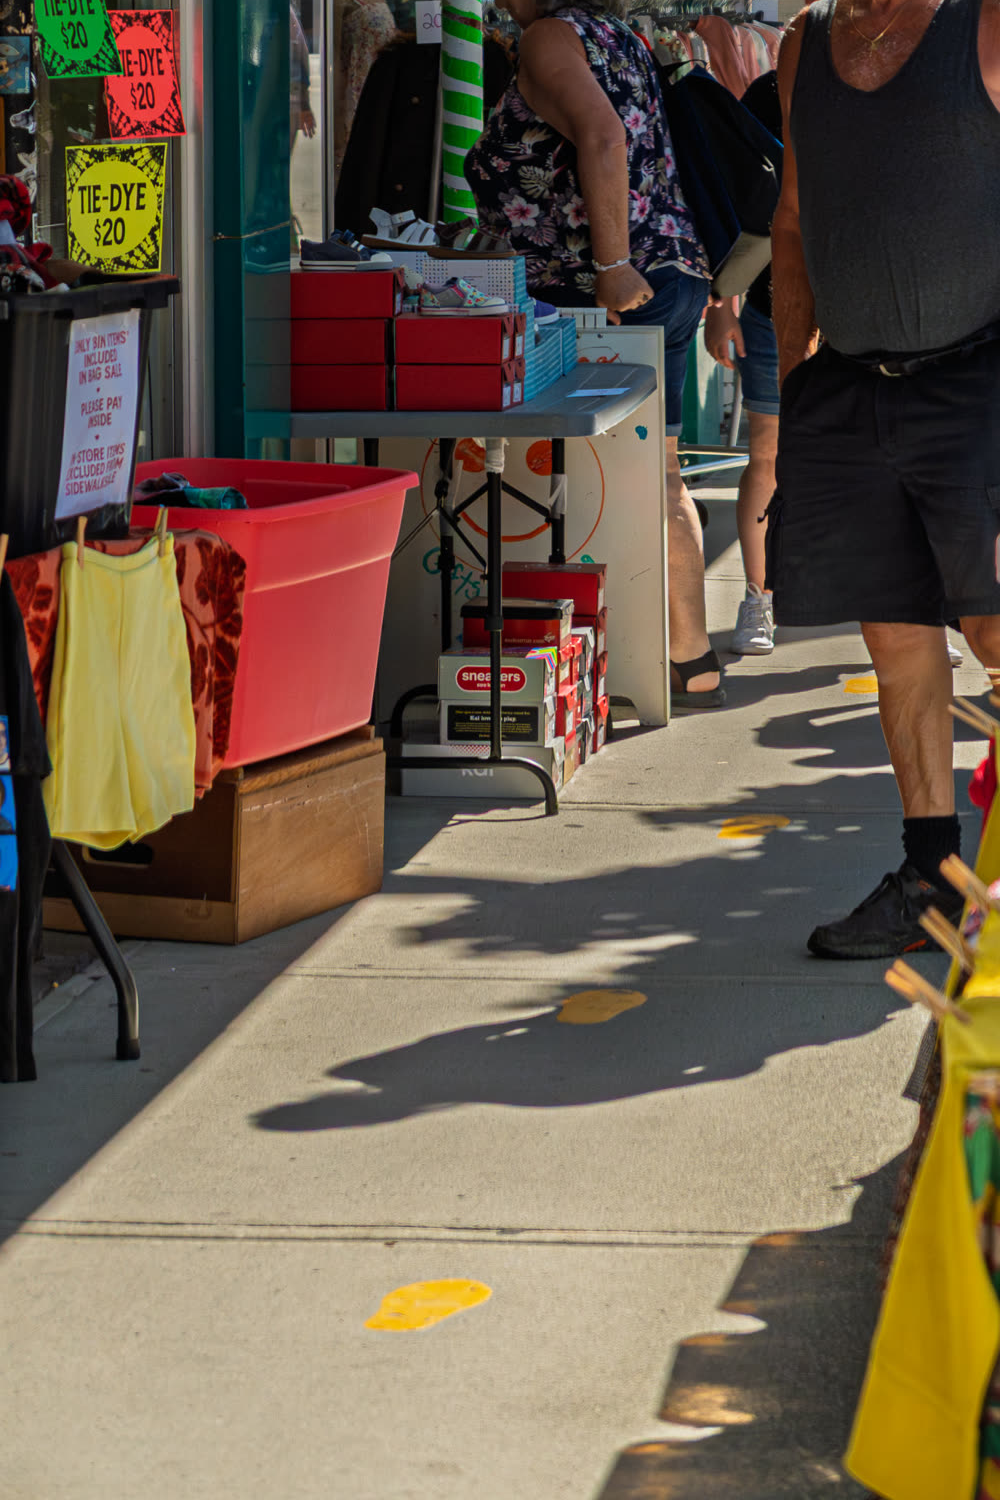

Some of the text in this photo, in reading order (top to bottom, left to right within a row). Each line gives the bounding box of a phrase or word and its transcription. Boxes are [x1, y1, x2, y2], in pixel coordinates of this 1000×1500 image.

[61, 20, 89, 50] $20
[117, 47, 165, 77] IE-DYE
[130, 81, 156, 111] $20
[78, 182, 147, 215] TIE-DYE
[94, 217, 126, 247] $20
[92, 334, 107, 349] BIN
[84, 348, 118, 368] INCLUDED
[79, 363, 123, 385] IN BAG SALE
[81, 395, 123, 417] PLEASE PAY
[88, 412, 112, 429] INSIDE
[461, 670, 521, 682] sneaers
